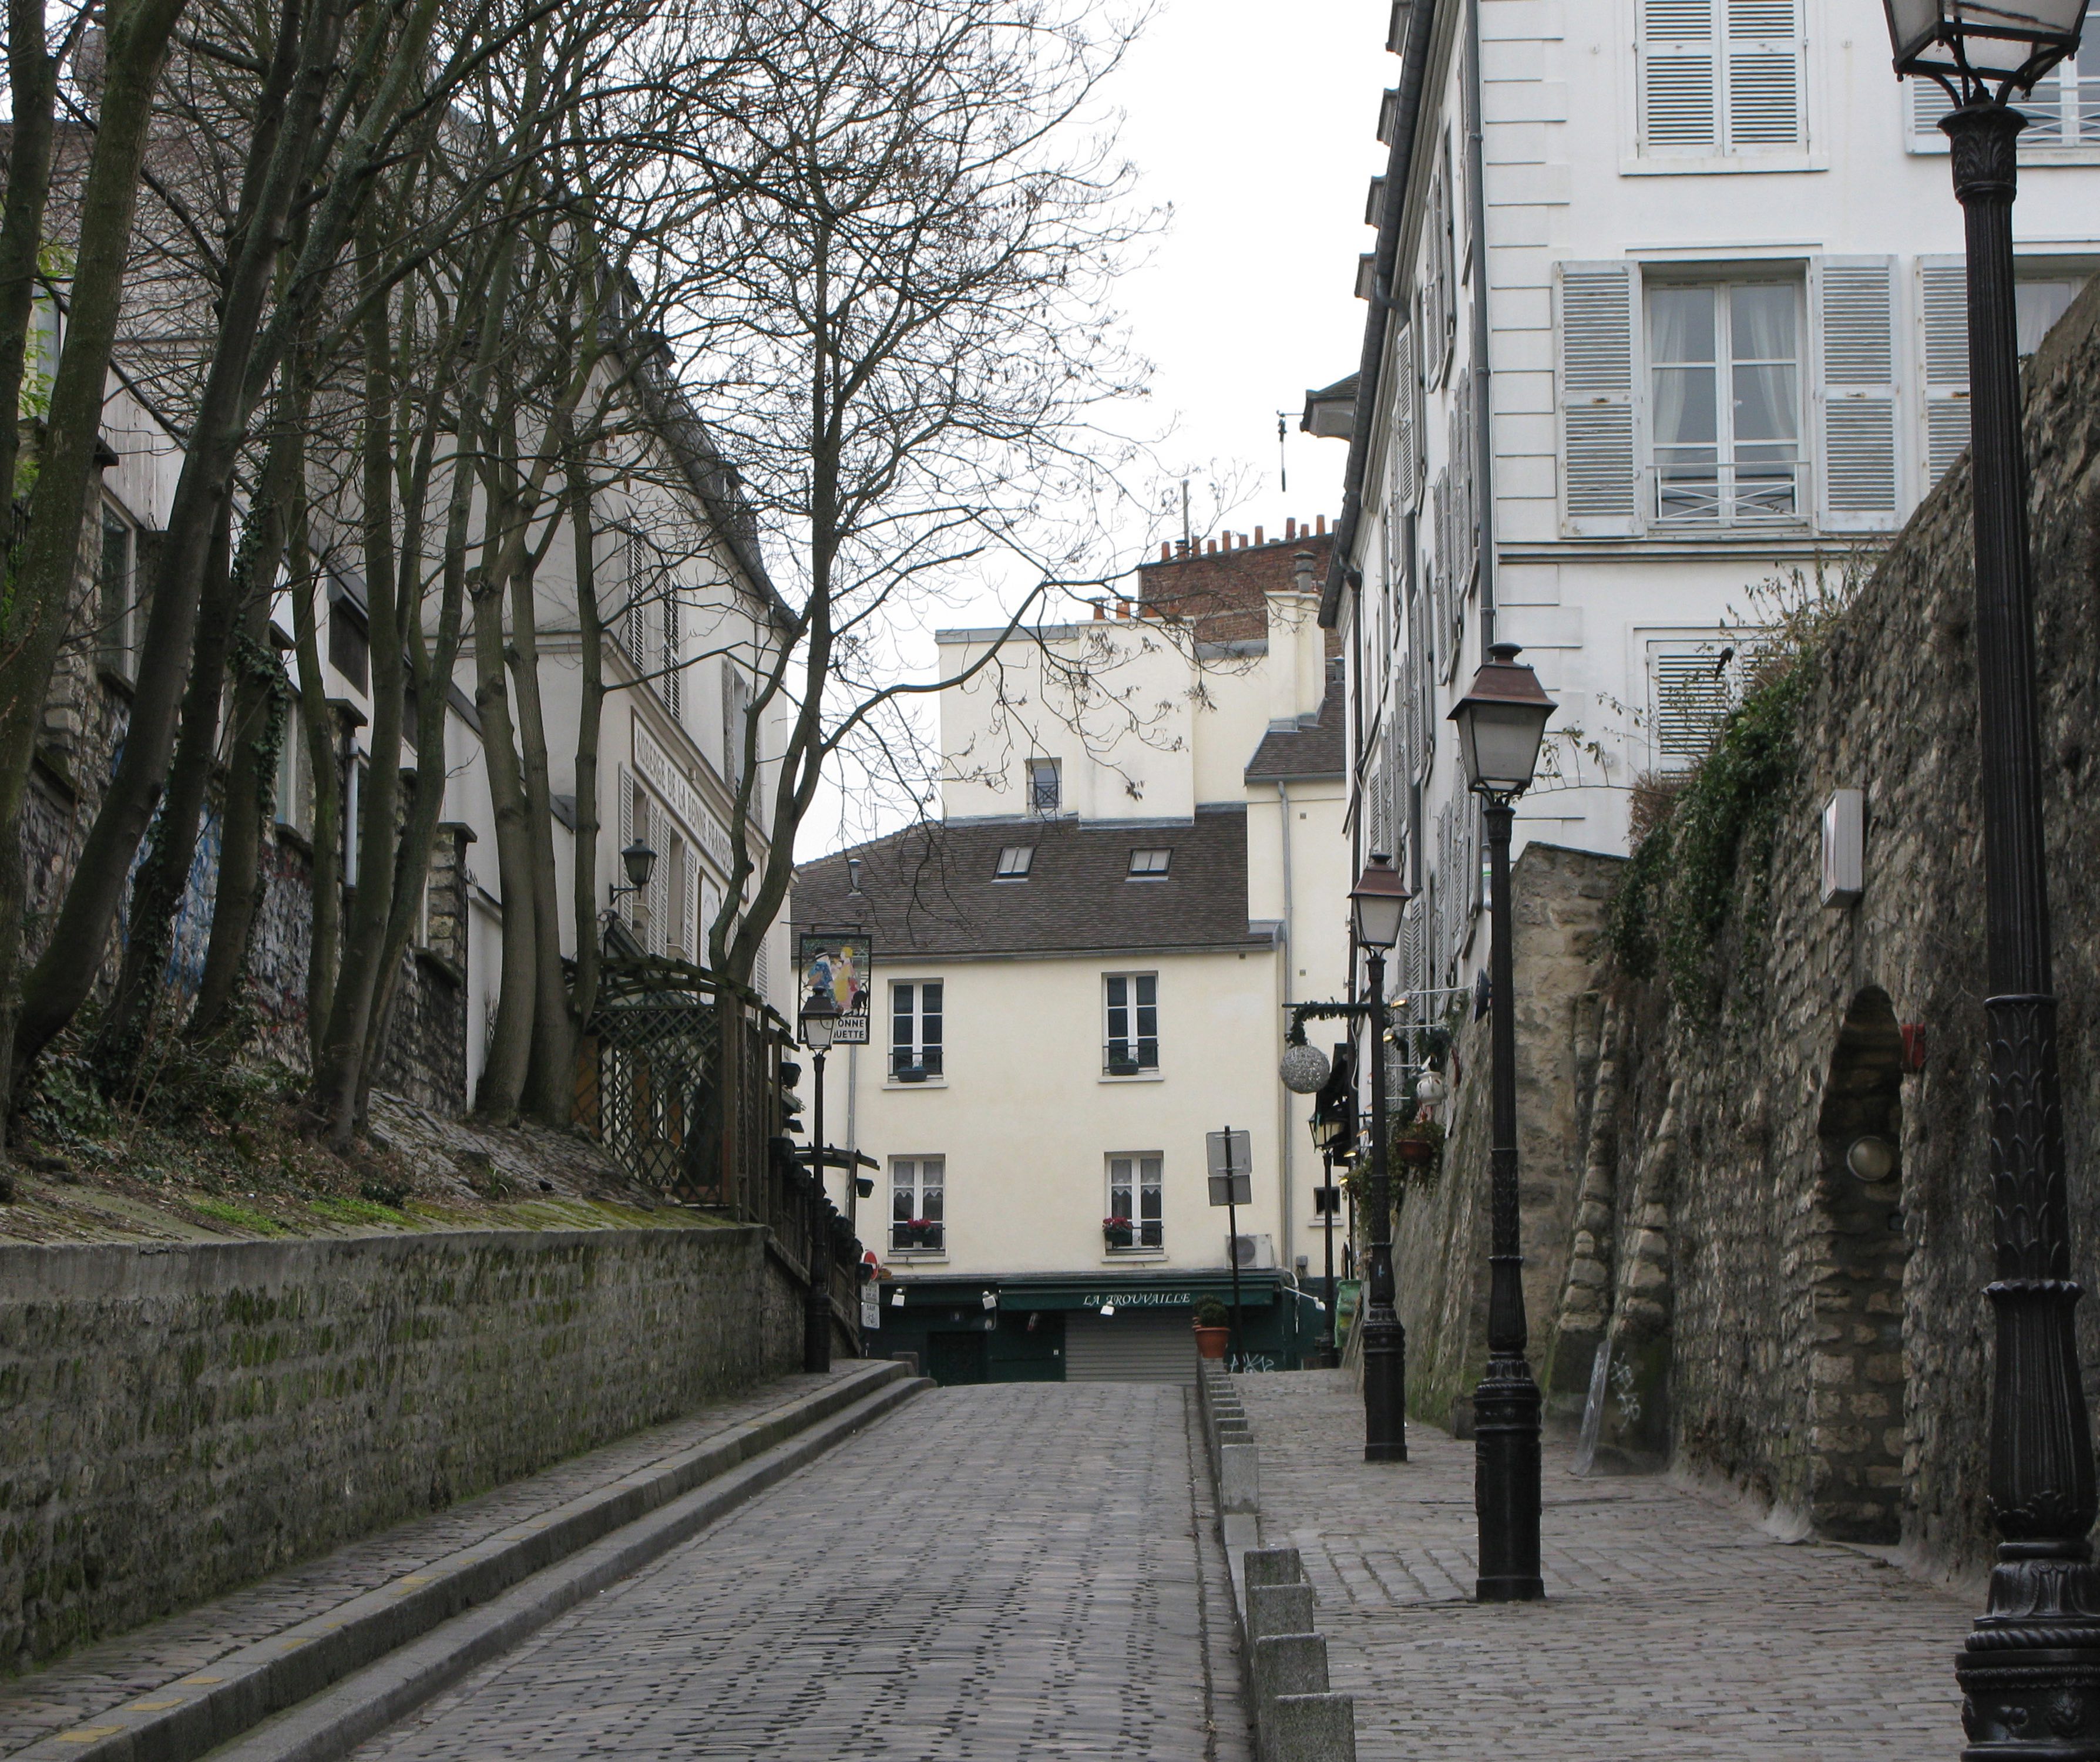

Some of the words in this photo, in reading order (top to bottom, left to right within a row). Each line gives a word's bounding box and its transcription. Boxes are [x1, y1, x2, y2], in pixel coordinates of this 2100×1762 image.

[637, 728, 666, 791] AUBERGE
[668, 766, 677, 803] DE
[678, 779, 686, 816] LA
[688, 792, 707, 842] BONNE
[838, 1019, 864, 1027] ONNE
[834, 1030, 864, 1039] UETTE
[1083, 1294, 1100, 1306] LA
[1106, 1293, 1191, 1306] TROUVAILLE
